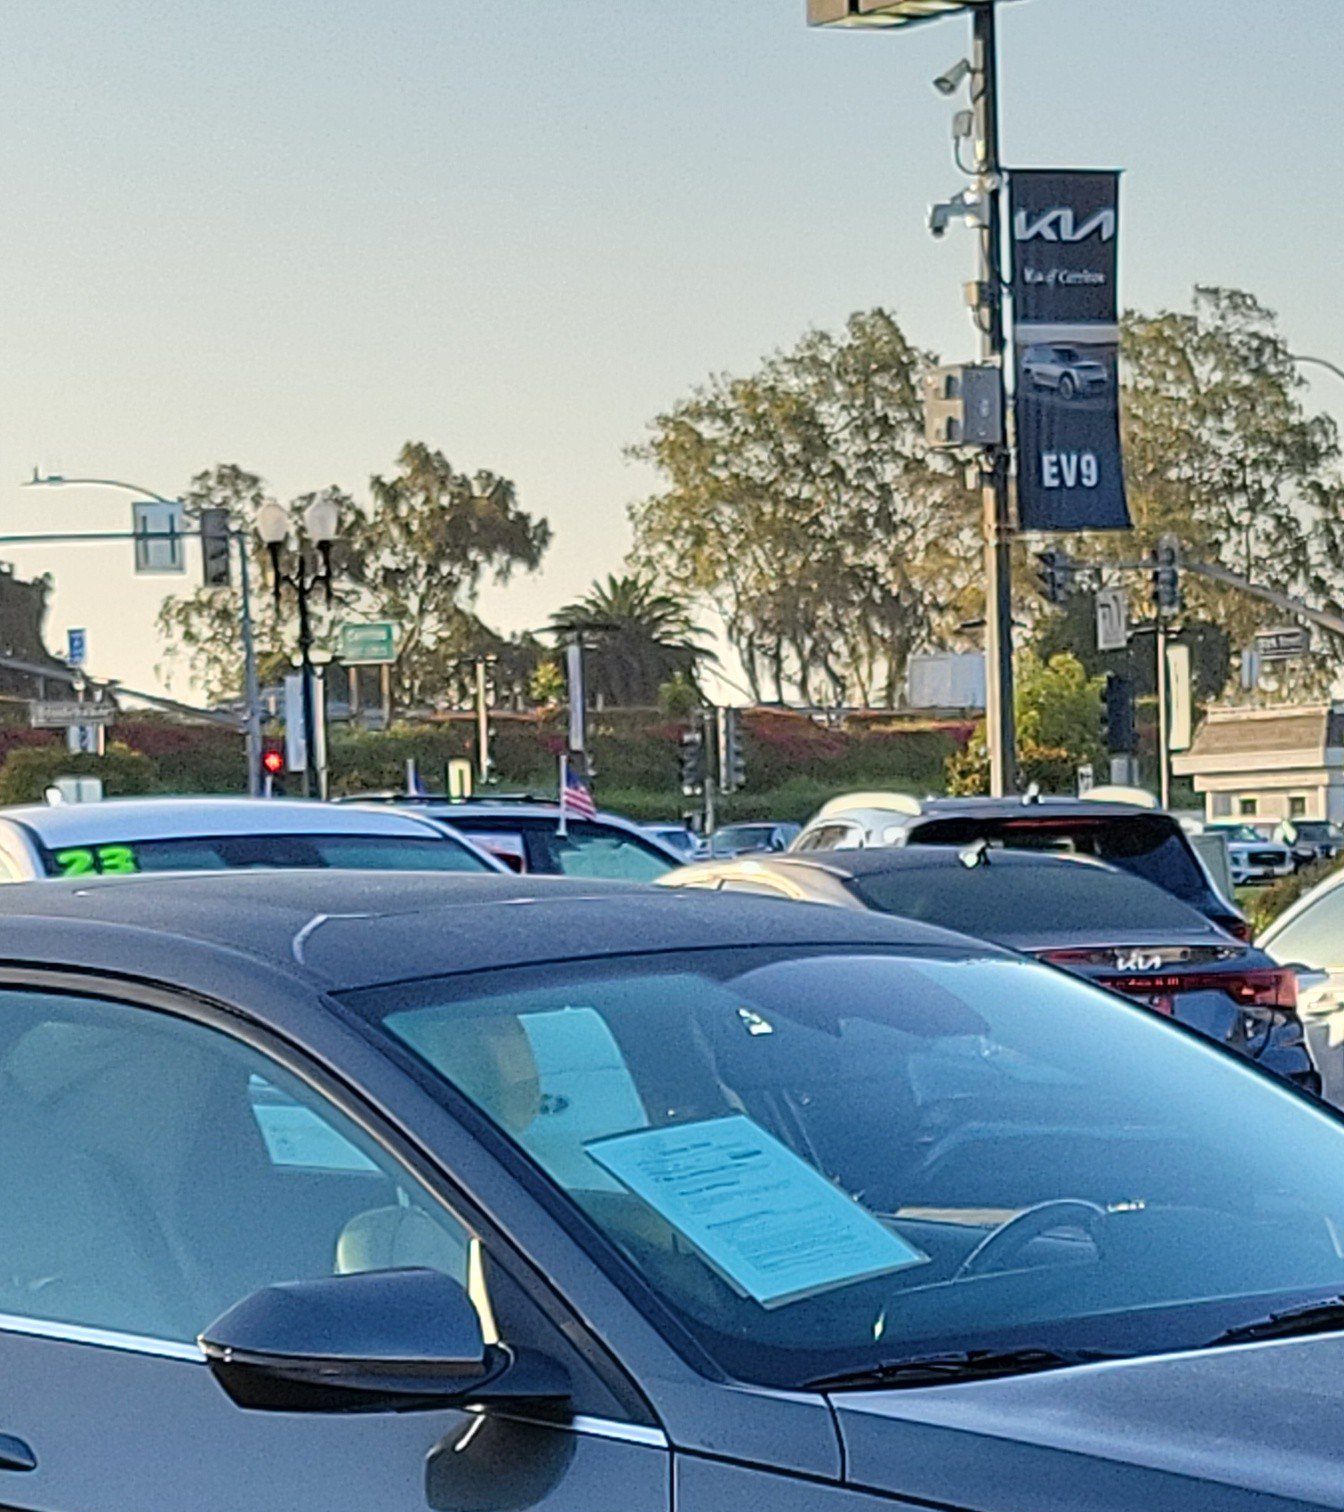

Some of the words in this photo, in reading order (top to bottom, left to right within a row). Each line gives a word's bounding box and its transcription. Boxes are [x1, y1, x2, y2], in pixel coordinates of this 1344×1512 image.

[1014, 208, 1115, 241] KIA
[1041, 453, 1098, 488] EV9
[57, 845, 133, 877] 23
